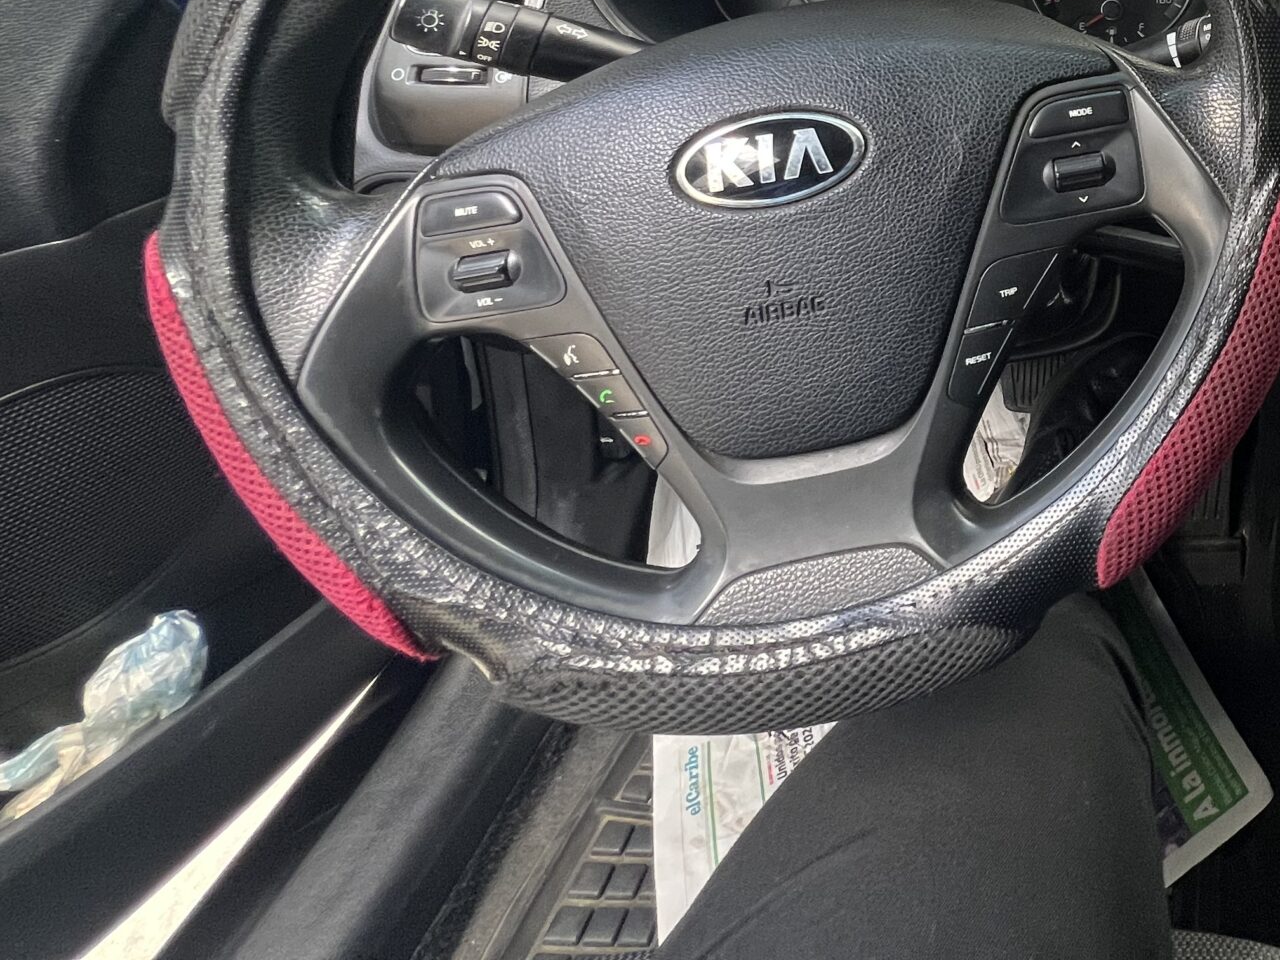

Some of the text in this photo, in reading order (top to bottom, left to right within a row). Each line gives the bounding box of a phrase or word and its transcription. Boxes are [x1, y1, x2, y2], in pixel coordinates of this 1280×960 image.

[1079, 22, 1085, 31] E
[1138, 22, 1145, 31] F
[1069, 107, 1093, 118] MODE
[704, 127, 834, 193] KIA
[454, 205, 478, 217] MUTE
[469, 239, 487, 249] VOL
[1000, 287, 1018, 298] TRIP
[476, 297, 493, 307] VOL
[744, 295, 827, 326] AIRBAG
[965, 352, 992, 366] RESET
[684, 745, 701, 816] elCaribe
[1182, 769, 1206, 804] la
[1193, 794, 1221, 822] A
